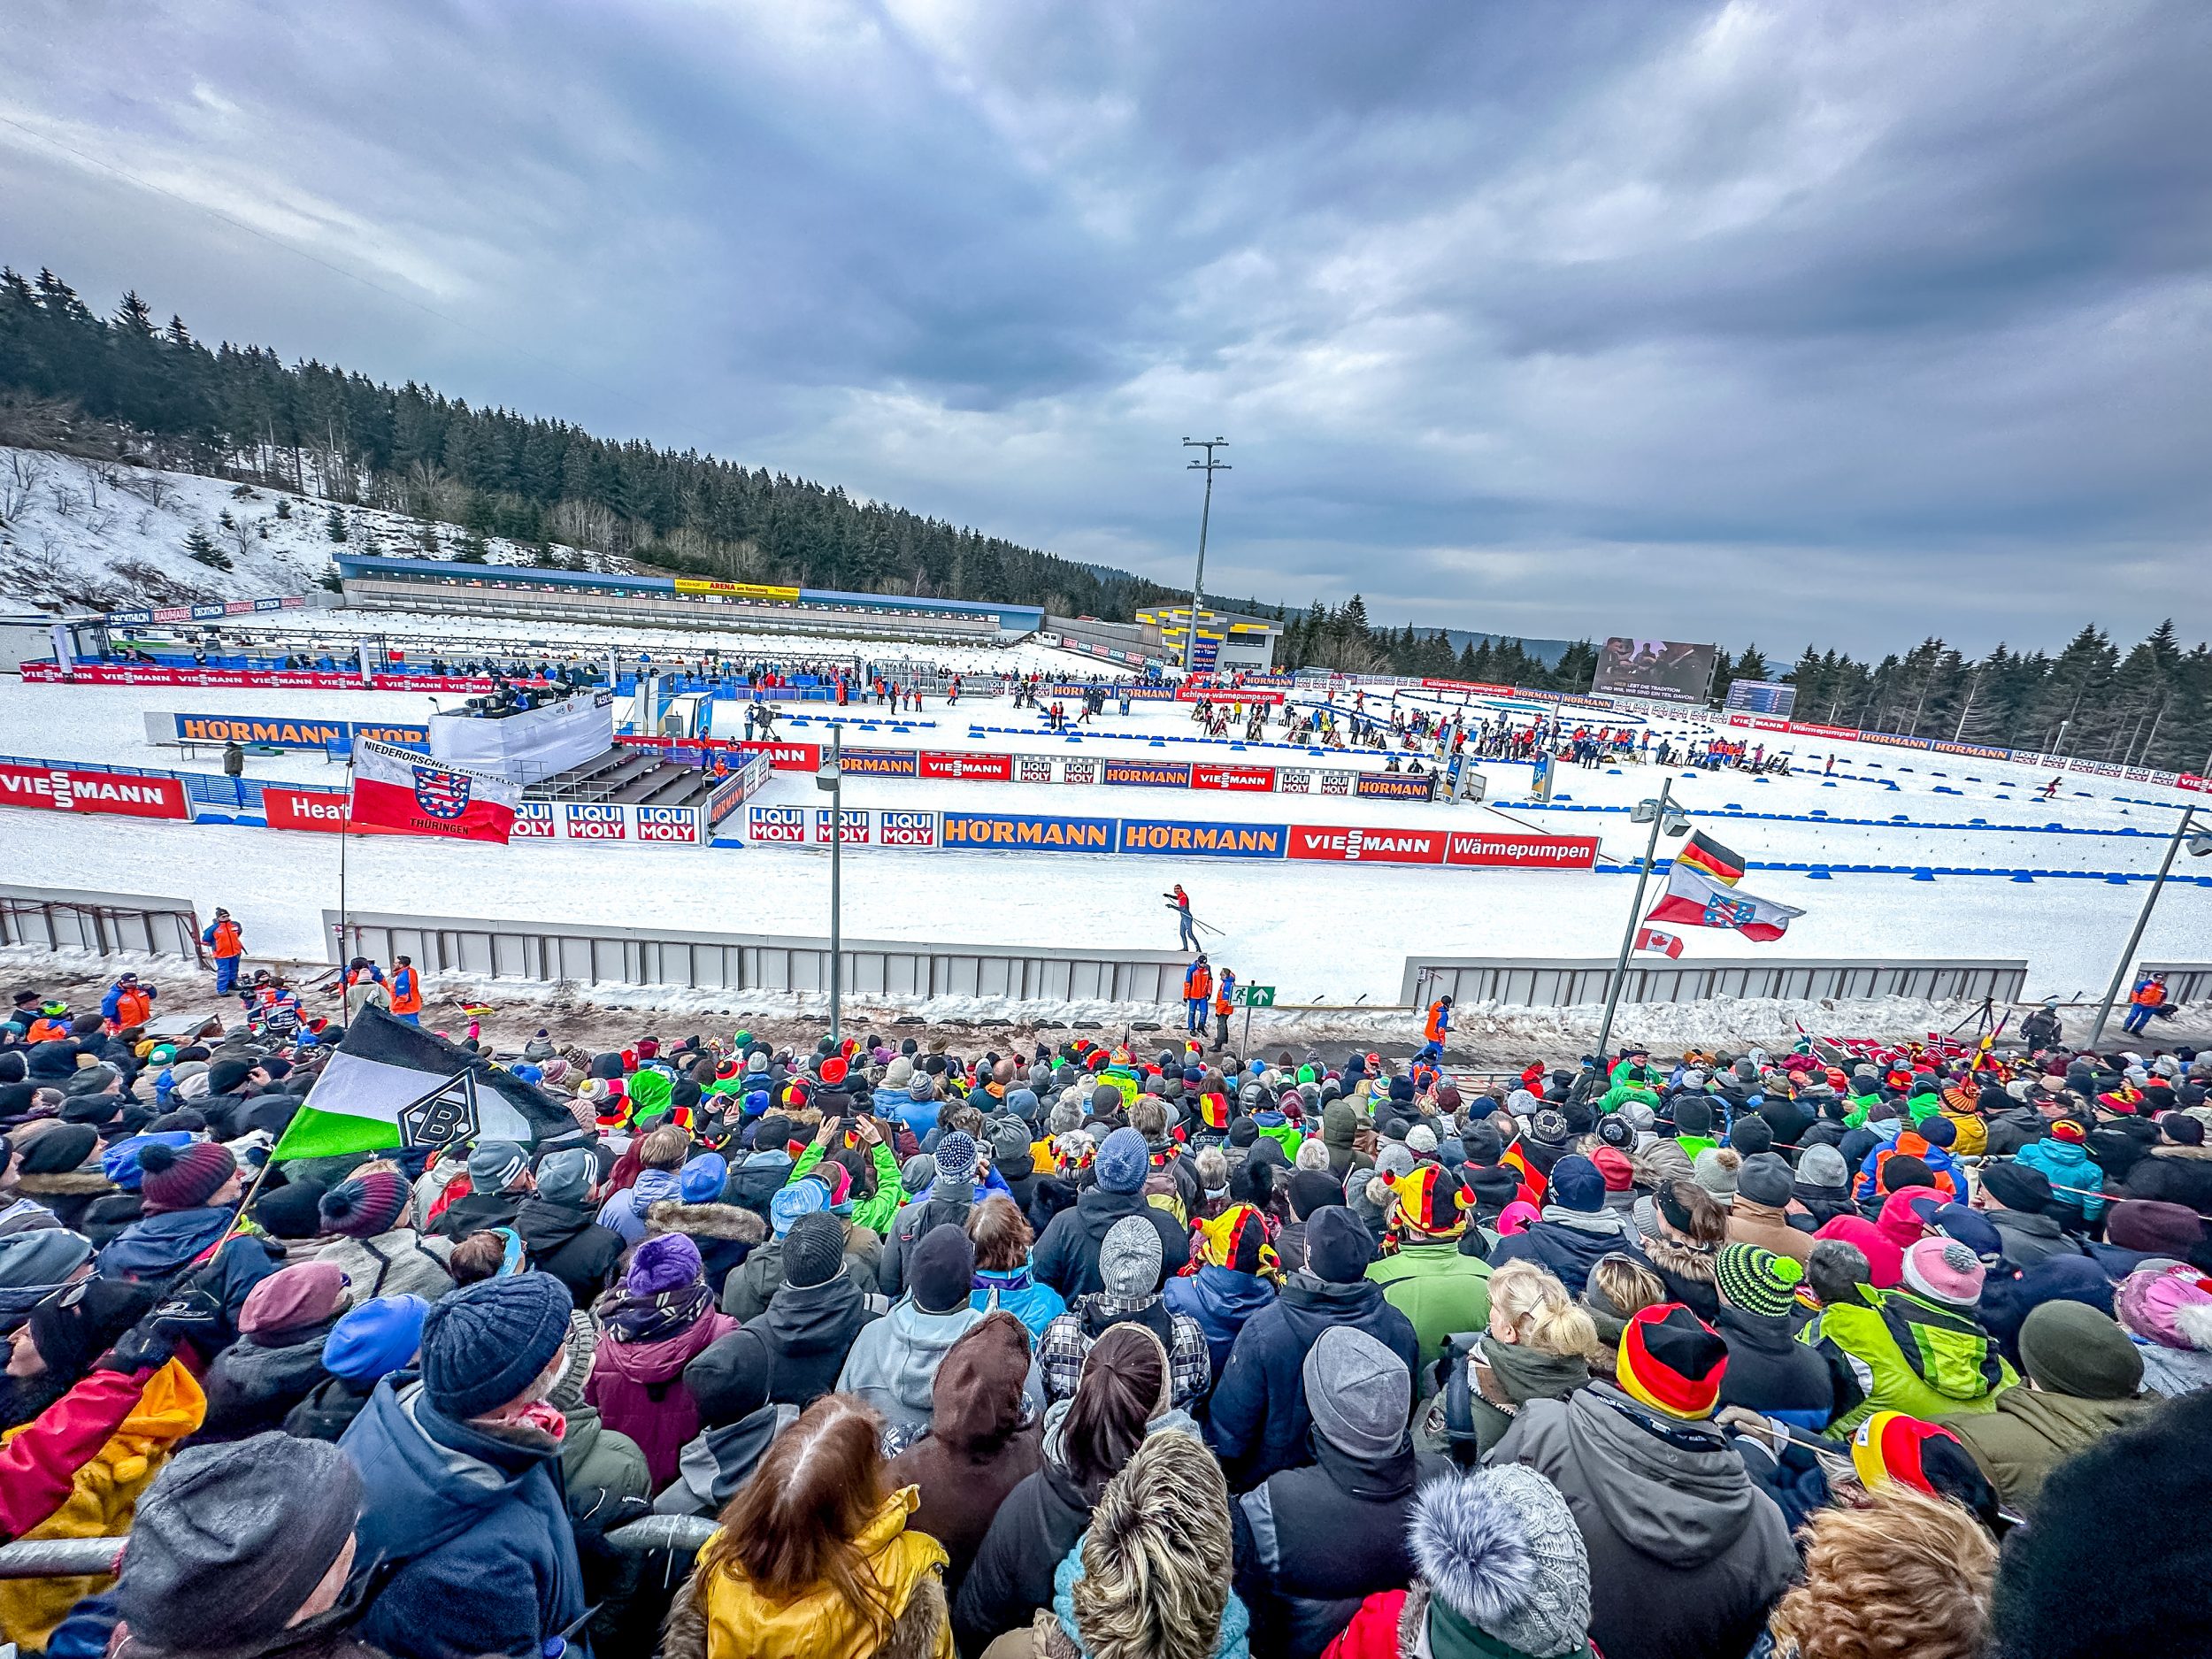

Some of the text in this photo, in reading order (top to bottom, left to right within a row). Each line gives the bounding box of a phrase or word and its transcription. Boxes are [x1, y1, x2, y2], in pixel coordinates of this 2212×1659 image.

[710, 582, 735, 591] ARENA
[110, 613, 149, 625] DECATHLON
[154, 608, 191, 621] BAUHAUS
[194, 606, 223, 617] DECATHLON
[101, 672, 171, 684] VIESSMANN
[178, 674, 243, 686] VIESSMANN
[250, 675, 312, 687] VIESSMANN
[385, 680, 442, 691] VIESSMANN
[1732, 717, 1784, 729] VIESSMANN
[184, 719, 339, 744] HÖRMANN
[1792, 724, 1856, 738] Wärmepumpen
[1862, 733, 1928, 749] HÖRMANN
[1936, 743, 2007, 758] HÖRMANN
[840, 757, 914, 772] ÖRMANN
[929, 760, 1002, 777] VIESSMANN
[1022, 762, 1050, 772] LIQUI
[1066, 764, 1093, 773] LIQUI
[1022, 772, 1050, 781] MOLY
[1065, 773, 1093, 783] MOLY
[1107, 768, 1187, 783] HÖRMANN
[1200, 772, 1266, 788] VIESSMANN
[1284, 775, 1309, 783] LIQUI
[2098, 769, 2120, 777] MOLY
[1283, 783, 1309, 793] MOLY
[1324, 777, 1348, 786] LIQUI
[2153, 777, 2174, 786] MOLY
[0, 772, 164, 808] VIESSMANN
[1322, 785, 1347, 794] MOLY
[514, 803, 550, 820] QUI
[569, 806, 622, 822] LIQUI
[639, 808, 692, 825] LIQUI
[752, 808, 802, 825] LIQUI
[410, 818, 469, 836] THÜRINGEN
[884, 813, 931, 829] LIQUI
[569, 823, 624, 839] MOLY
[640, 825, 694, 841] MOLY
[752, 826, 803, 841] MOLY
[883, 829, 932, 845] MOLY
[945, 818, 1107, 845] HÖRMANN
[1125, 825, 1278, 852] HÖRMANN
[1303, 830, 1430, 859] VIESSMANN
[1454, 837, 1590, 860] Wärmepumpen
